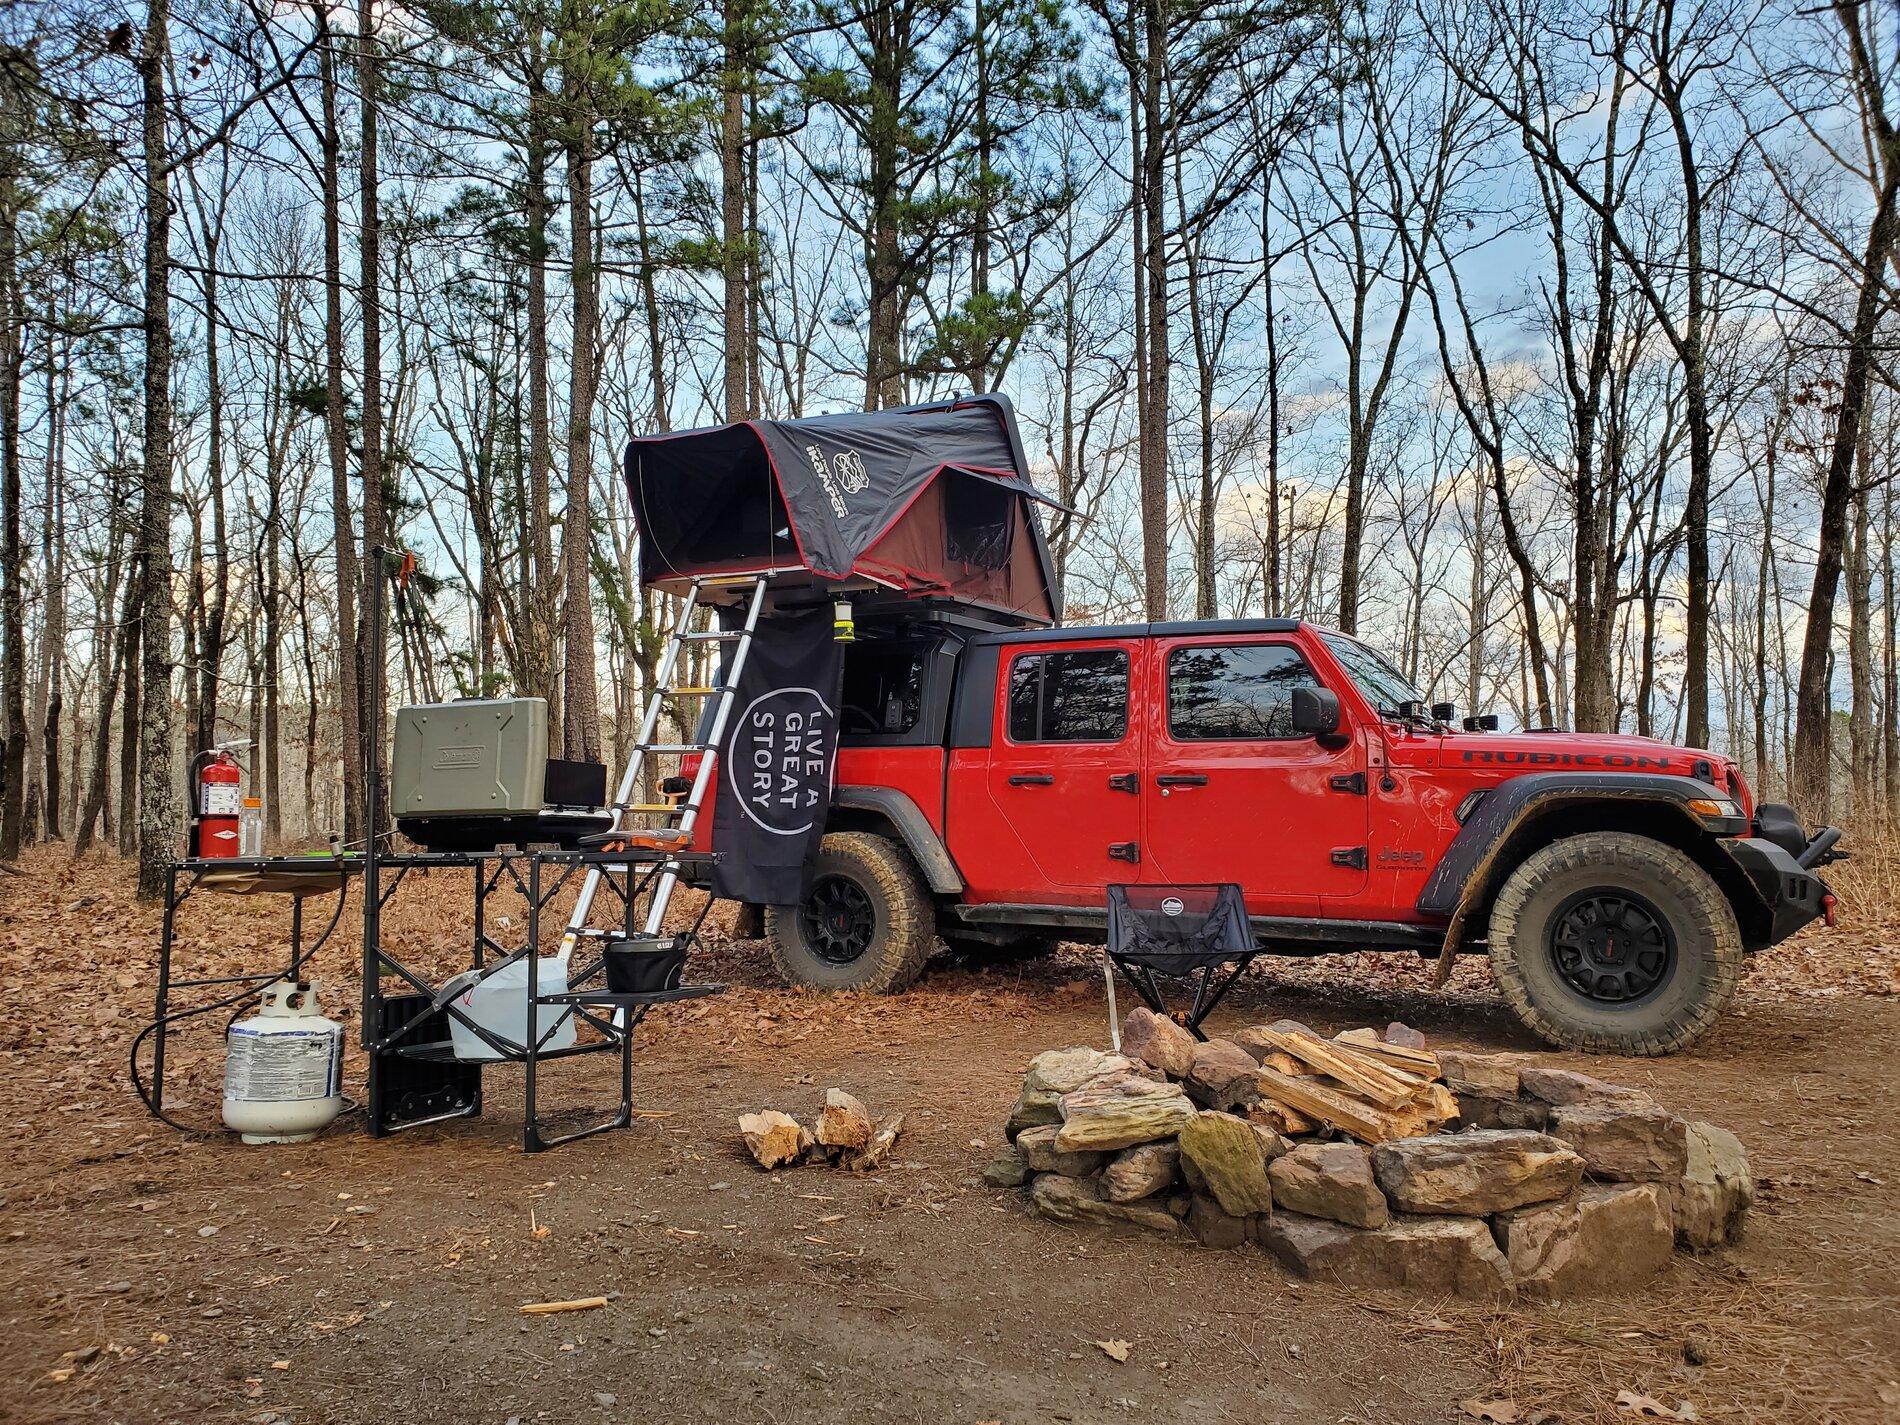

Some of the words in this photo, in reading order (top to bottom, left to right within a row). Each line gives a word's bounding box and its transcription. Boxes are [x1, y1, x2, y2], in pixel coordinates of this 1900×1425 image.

[752, 711, 775, 809] STORY
[780, 712, 803, 809] GREAT
[805, 711, 824, 776] LIVE
[1464, 750, 1670, 769] RUBICON
[806, 788, 819, 807] A
[1376, 844, 1425, 866] Jeep
